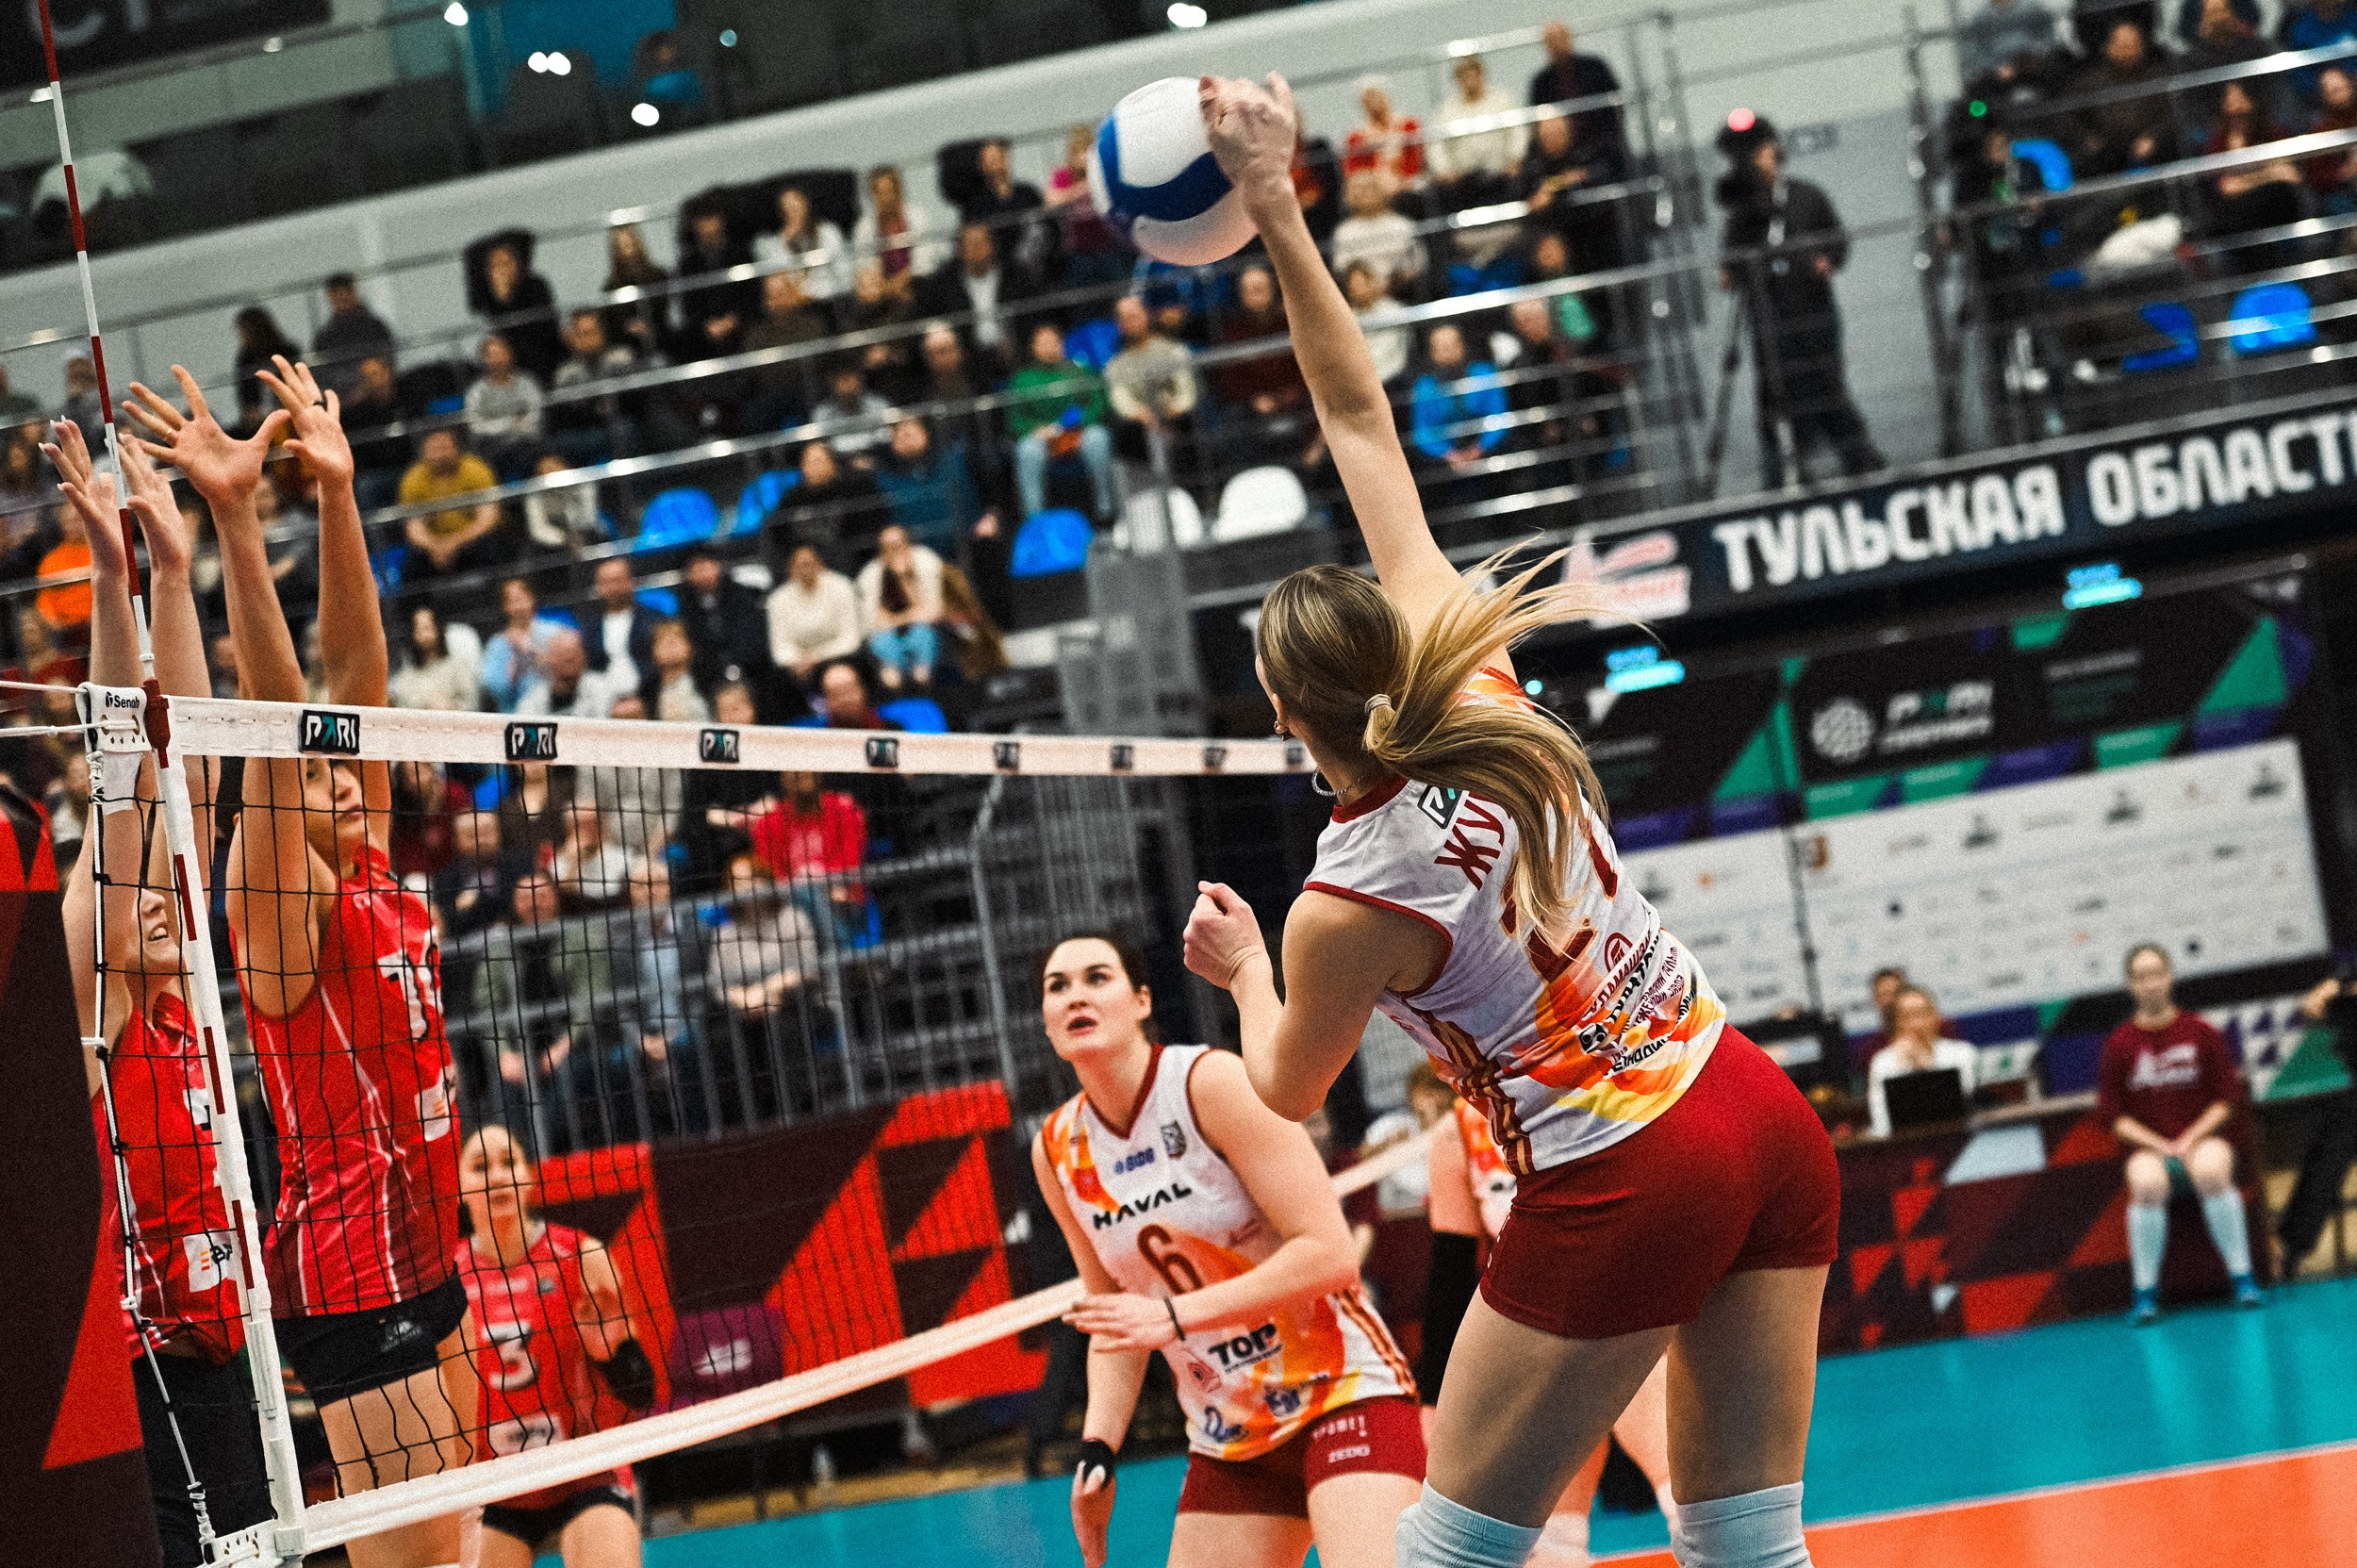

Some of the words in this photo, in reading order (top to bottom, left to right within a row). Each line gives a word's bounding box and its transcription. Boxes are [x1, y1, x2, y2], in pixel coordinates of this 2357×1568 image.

[1712, 464, 2066, 592] ТУЛЬСКАЯ
[1093, 1183, 1193, 1230] HAVAL
[1136, 1224, 1205, 1296] 6
[481, 1320, 539, 1392] 3
